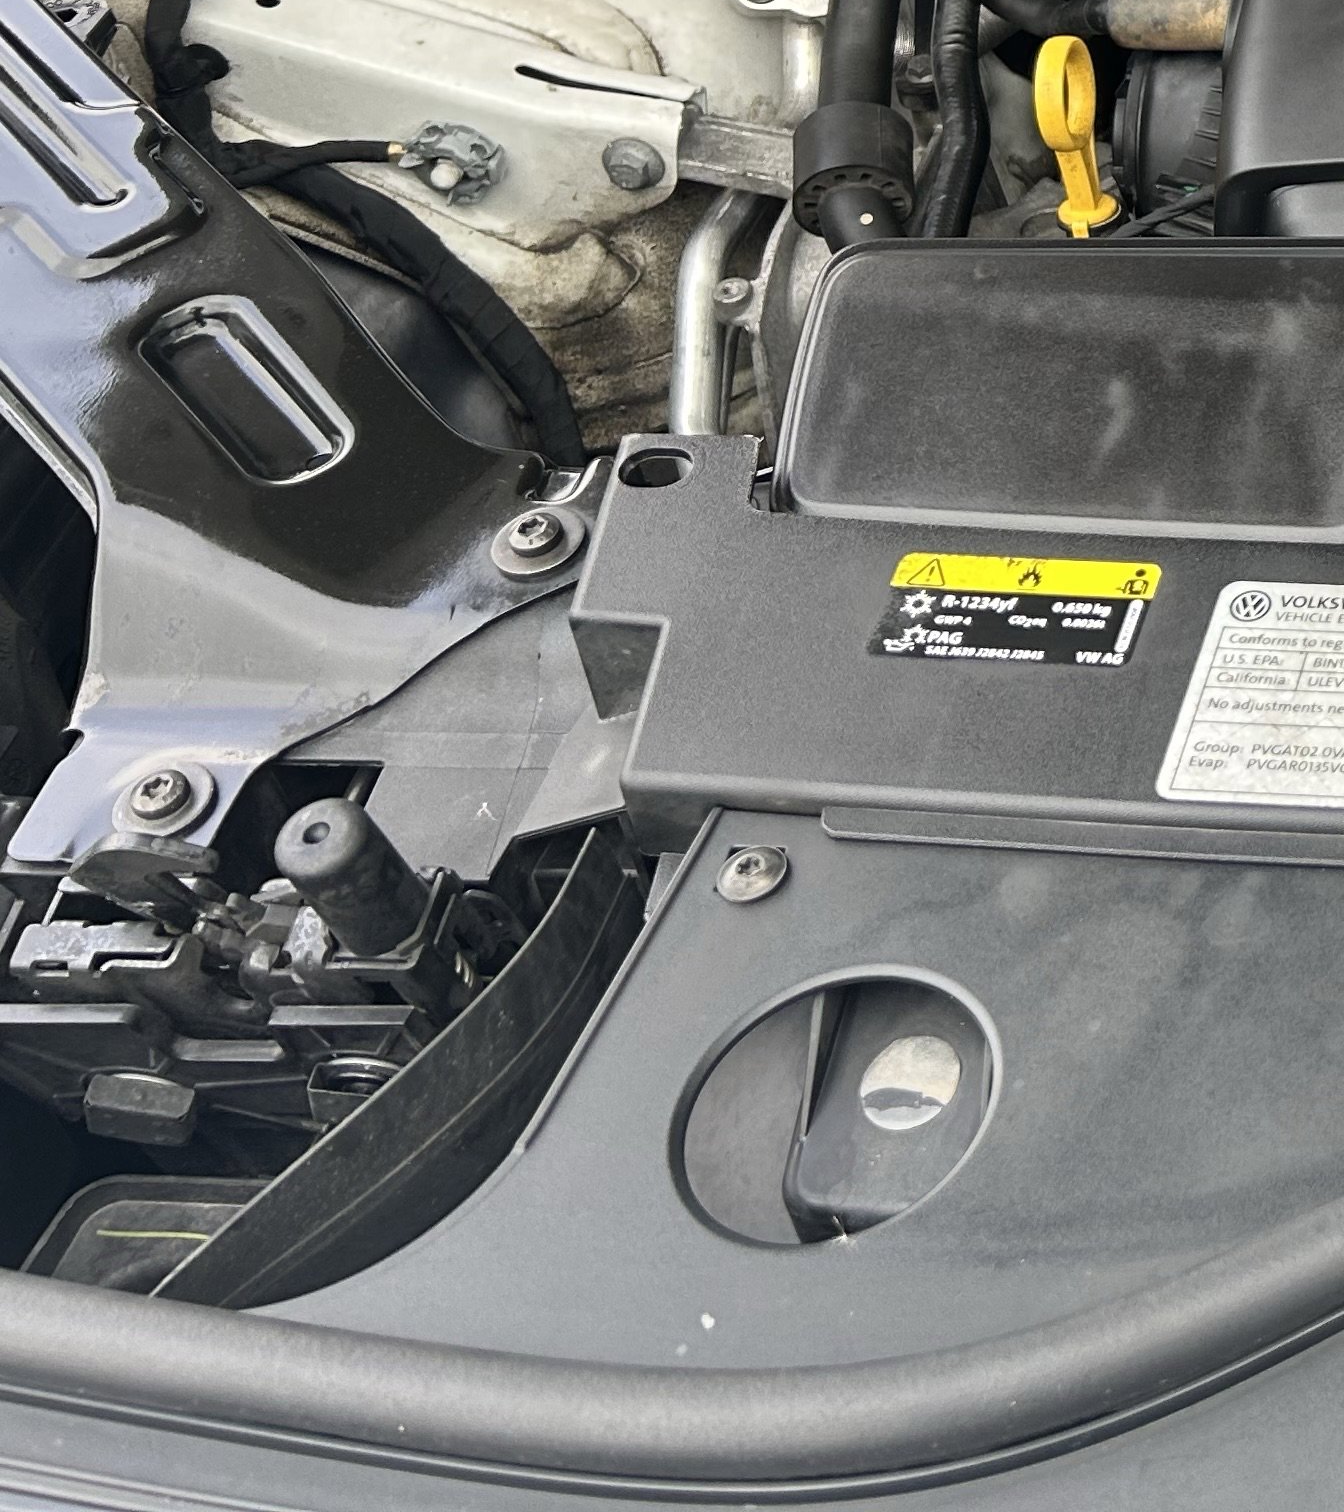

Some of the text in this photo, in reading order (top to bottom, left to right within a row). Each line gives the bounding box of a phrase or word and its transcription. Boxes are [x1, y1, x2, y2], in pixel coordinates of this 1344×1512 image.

[942, 594, 1019, 613] R-1234yf
[1276, 611, 1332, 623] VEHICLE
[927, 630, 964, 644] PAG
[1229, 633, 1298, 647] Conforms
[1302, 637, 1317, 647] to
[1076, 651, 1124, 665] VW AG
[1208, 698, 1228, 710] No
[1232, 699, 1324, 715] adjustments
